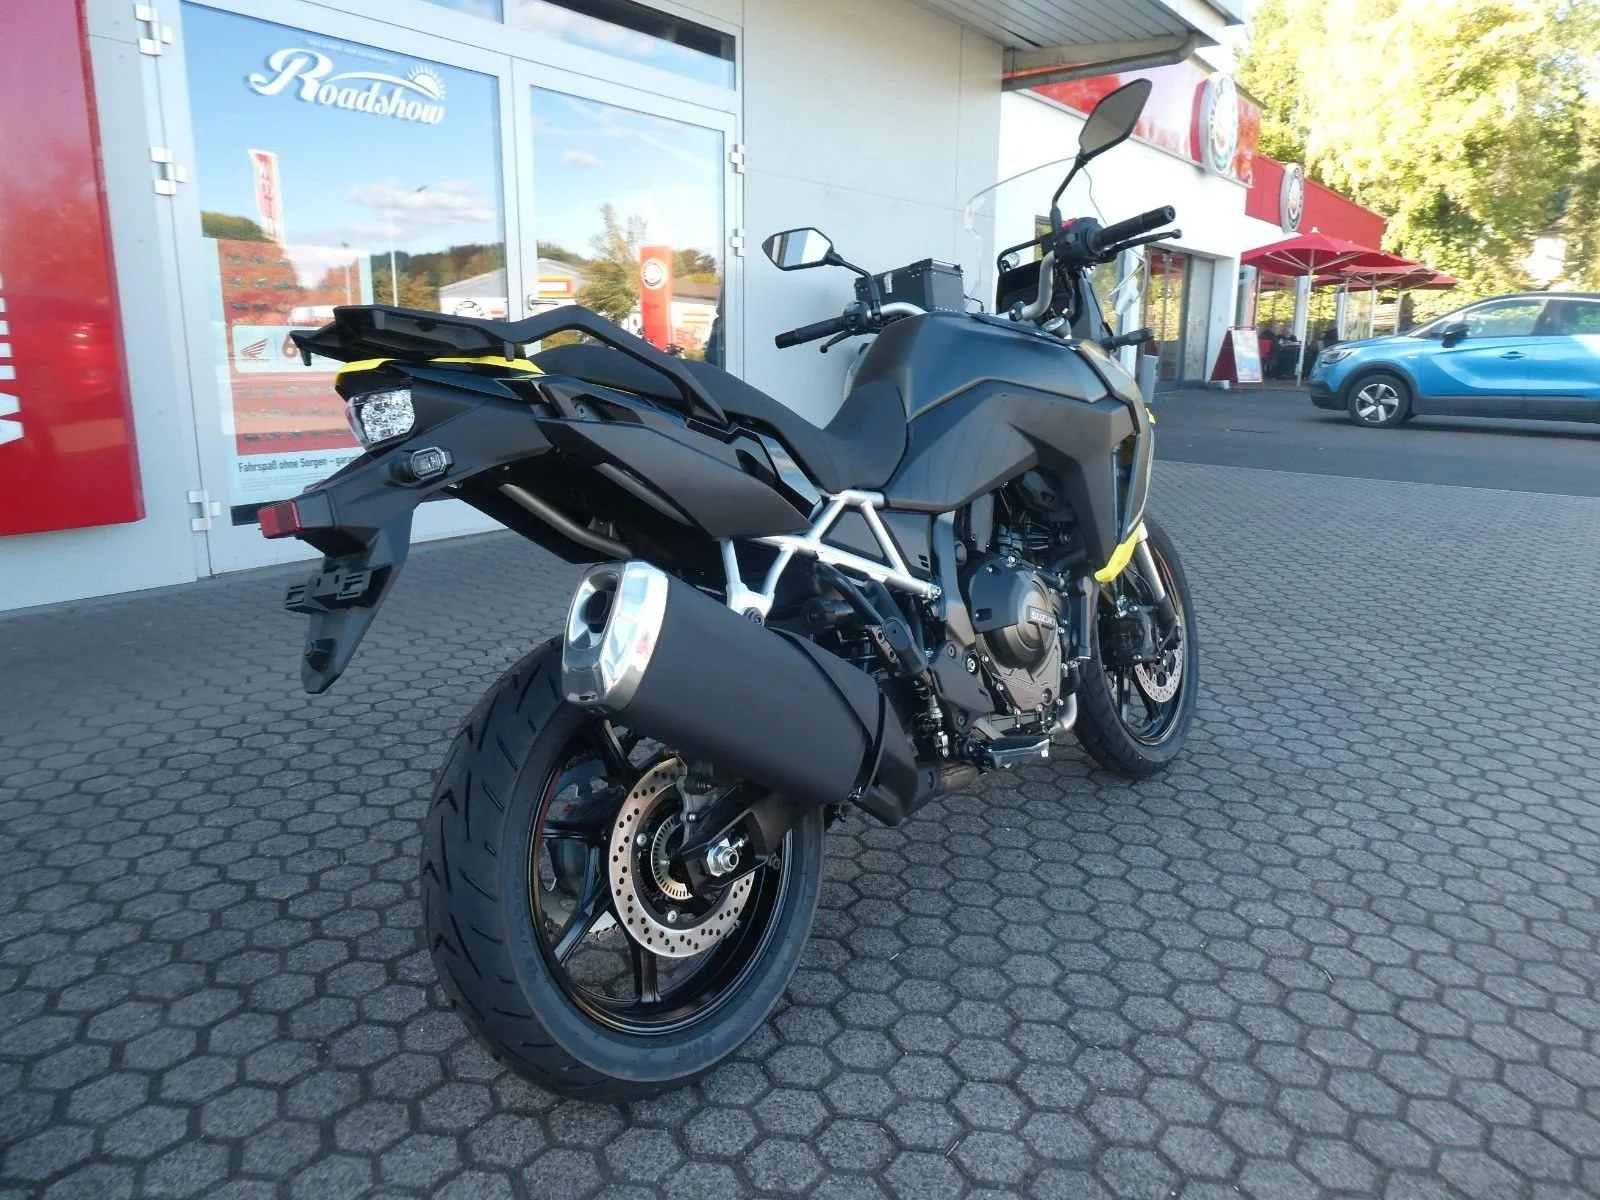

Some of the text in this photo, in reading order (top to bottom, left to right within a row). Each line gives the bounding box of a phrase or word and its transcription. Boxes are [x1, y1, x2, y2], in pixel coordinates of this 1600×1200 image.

[248, 48, 446, 125] Roadshow
[238, 460, 277, 473] Fahrspaß
[280, 460, 298, 469] ohne
[300, 458, 327, 469] Sorgen
